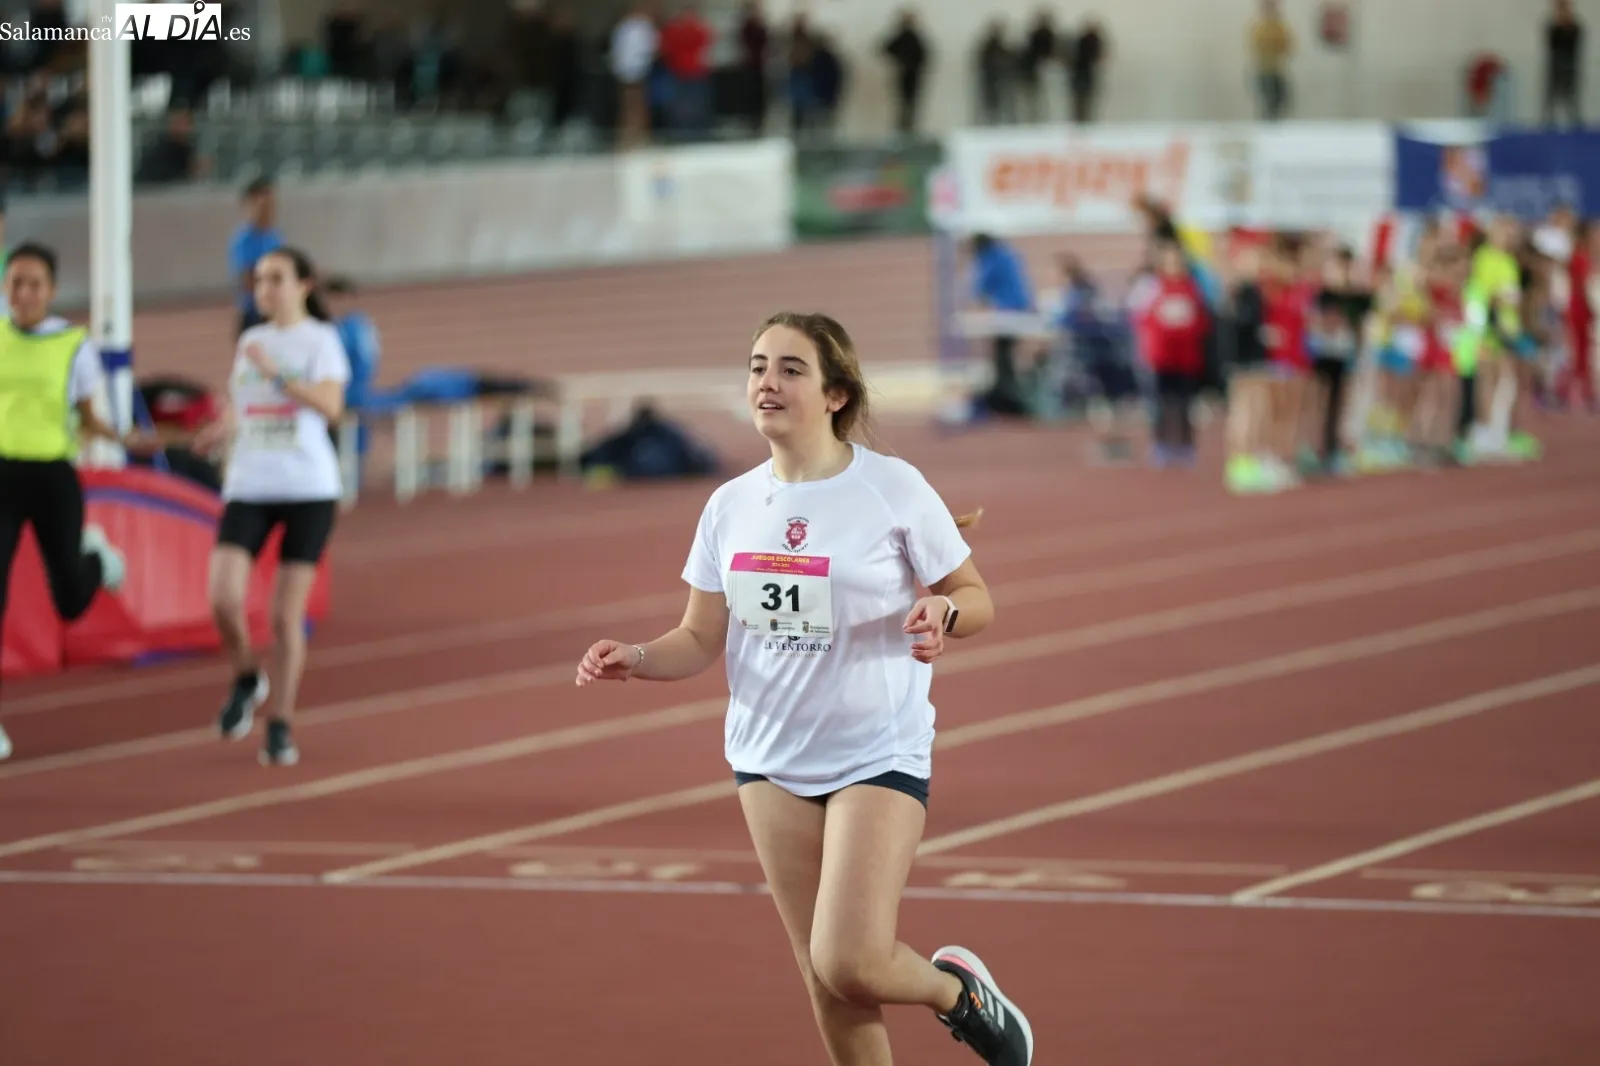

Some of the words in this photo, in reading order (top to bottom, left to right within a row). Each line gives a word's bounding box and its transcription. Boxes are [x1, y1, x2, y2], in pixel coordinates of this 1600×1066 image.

[776, 556, 810, 564] ESCOLARES
[761, 583, 800, 612] 31
[775, 640, 832, 652] VENTORRO
